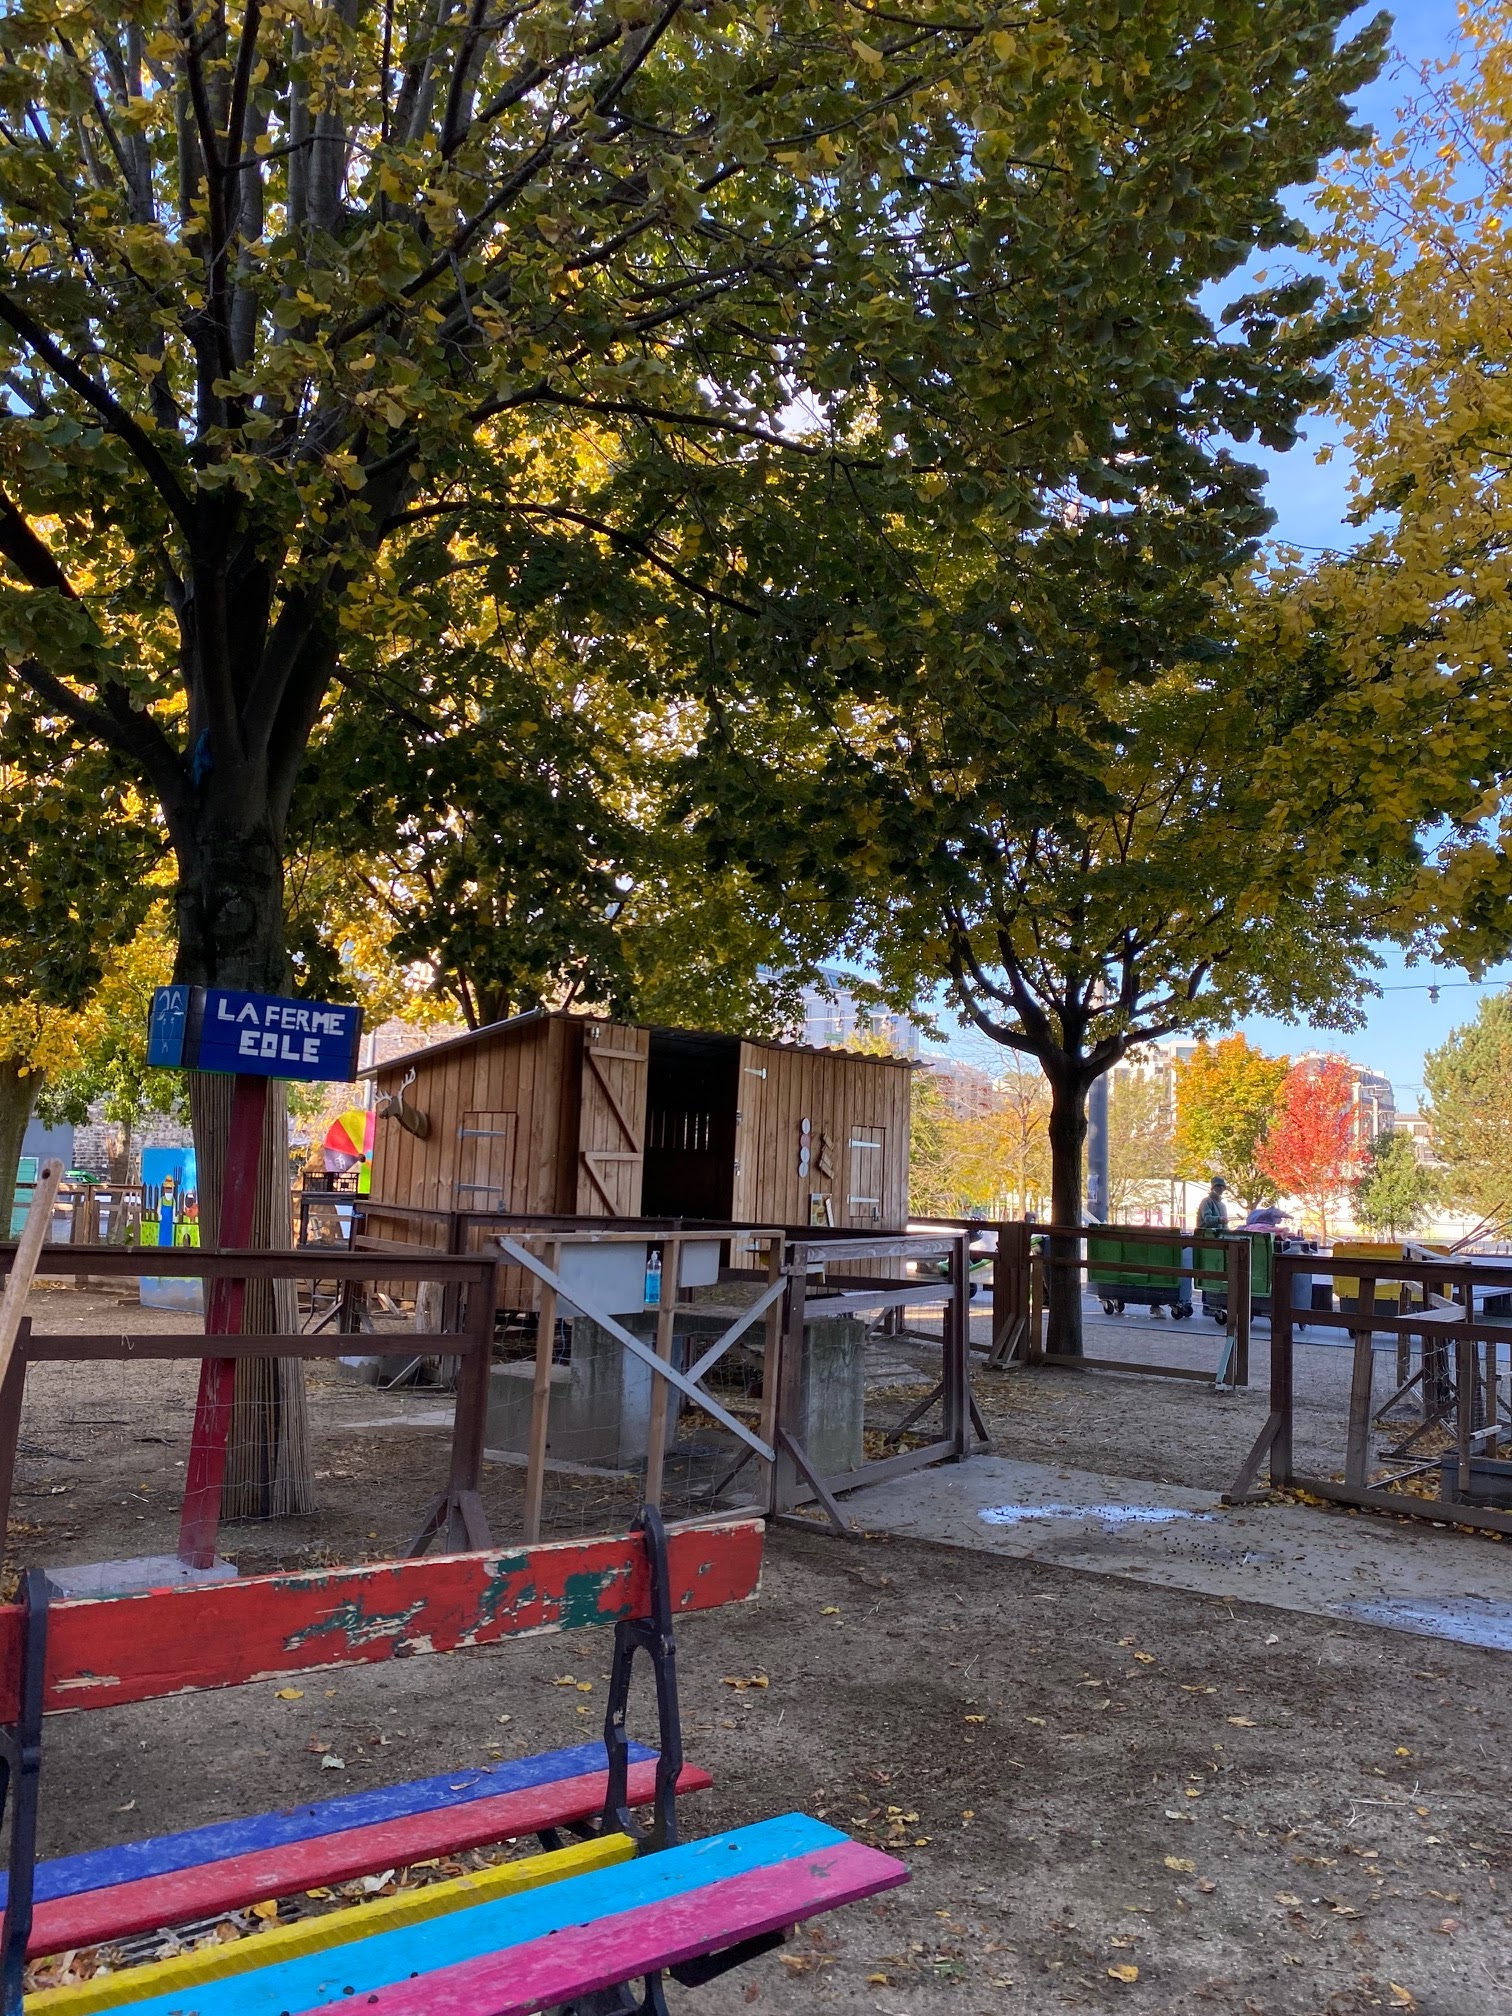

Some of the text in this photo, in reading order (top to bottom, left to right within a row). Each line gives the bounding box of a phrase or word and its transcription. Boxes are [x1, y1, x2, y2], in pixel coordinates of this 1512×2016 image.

[217, 998, 346, 1036] LA FERME
[238, 1030, 321, 1063] EOLE
